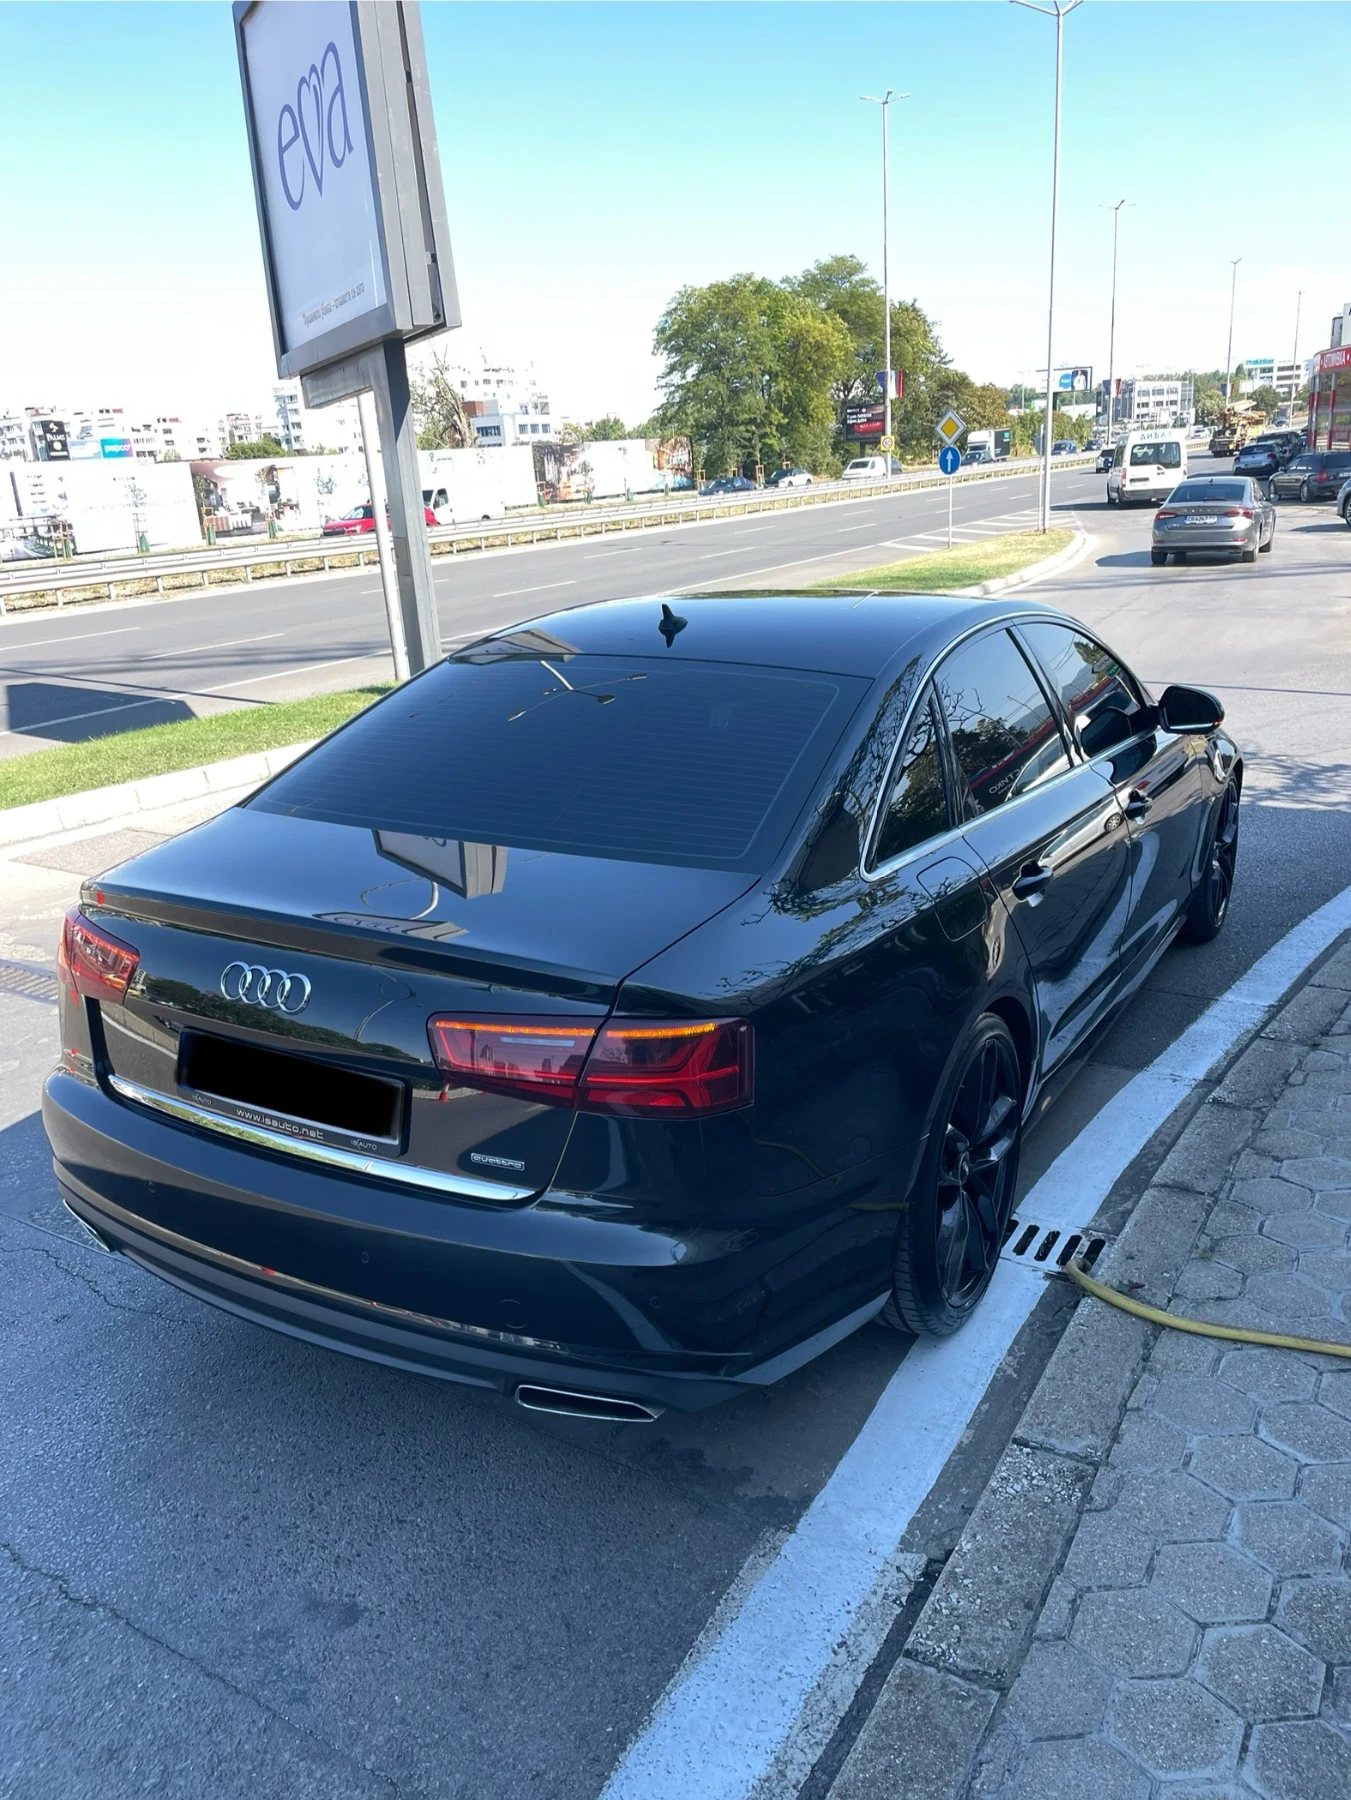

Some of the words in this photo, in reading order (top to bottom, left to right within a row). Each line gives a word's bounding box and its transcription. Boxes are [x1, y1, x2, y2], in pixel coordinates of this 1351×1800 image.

[277, 41, 354, 211] eva
[236, 1108, 324, 1140] www.isauto.net
[471, 1154, 523, 1169] quattro
